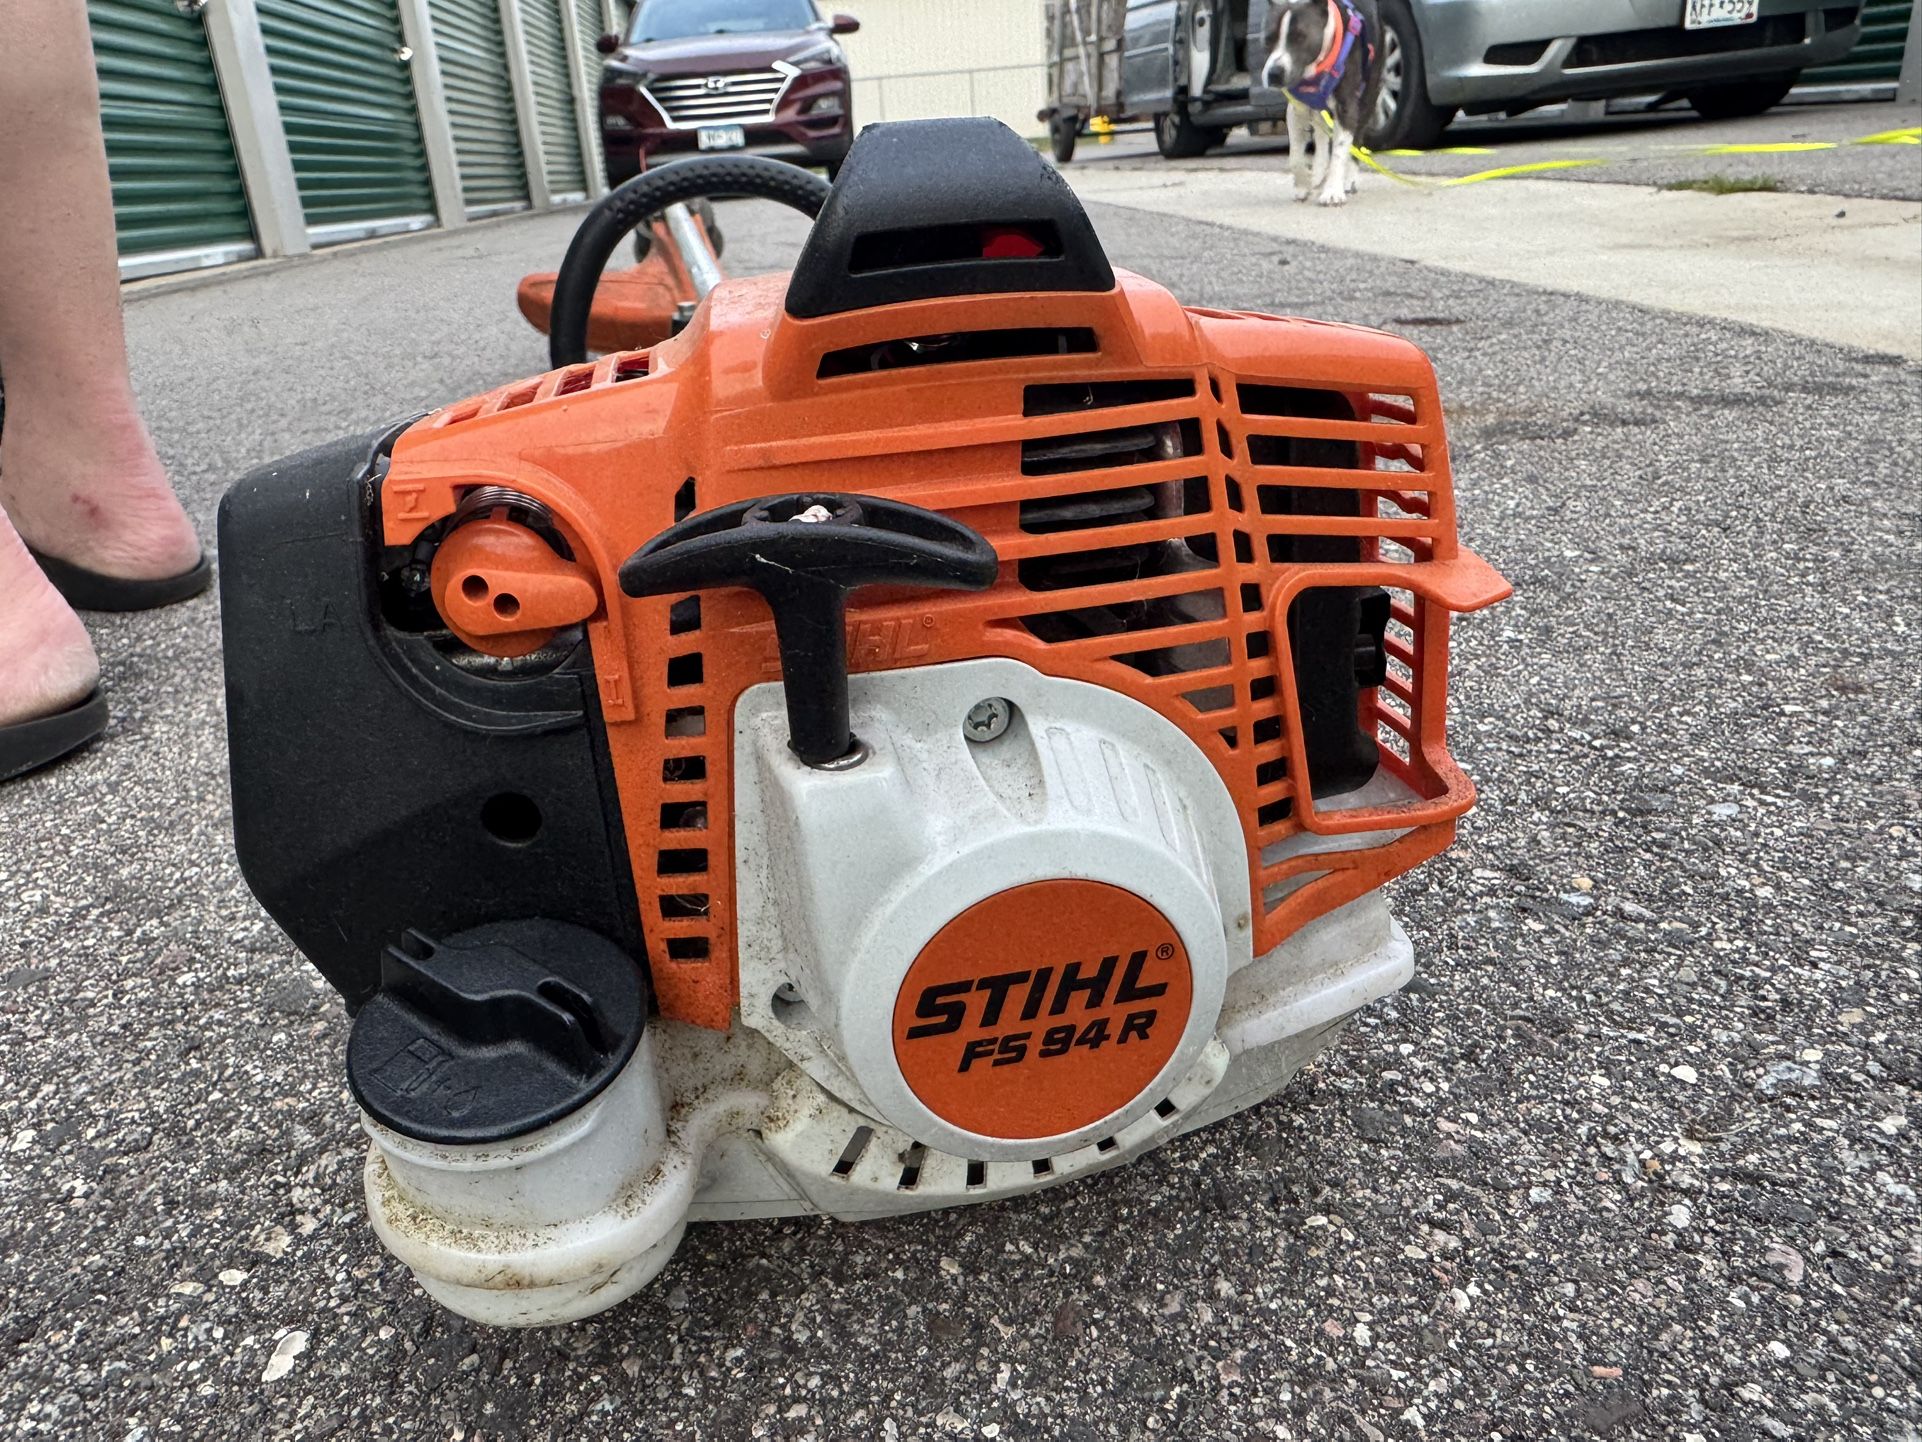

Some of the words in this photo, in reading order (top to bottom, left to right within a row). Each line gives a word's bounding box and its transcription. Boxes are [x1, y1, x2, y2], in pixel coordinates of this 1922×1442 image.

[957, 1031, 1033, 1073] FS
[1038, 1017, 1111, 1058] 94
[1116, 1008, 1158, 1045] R
